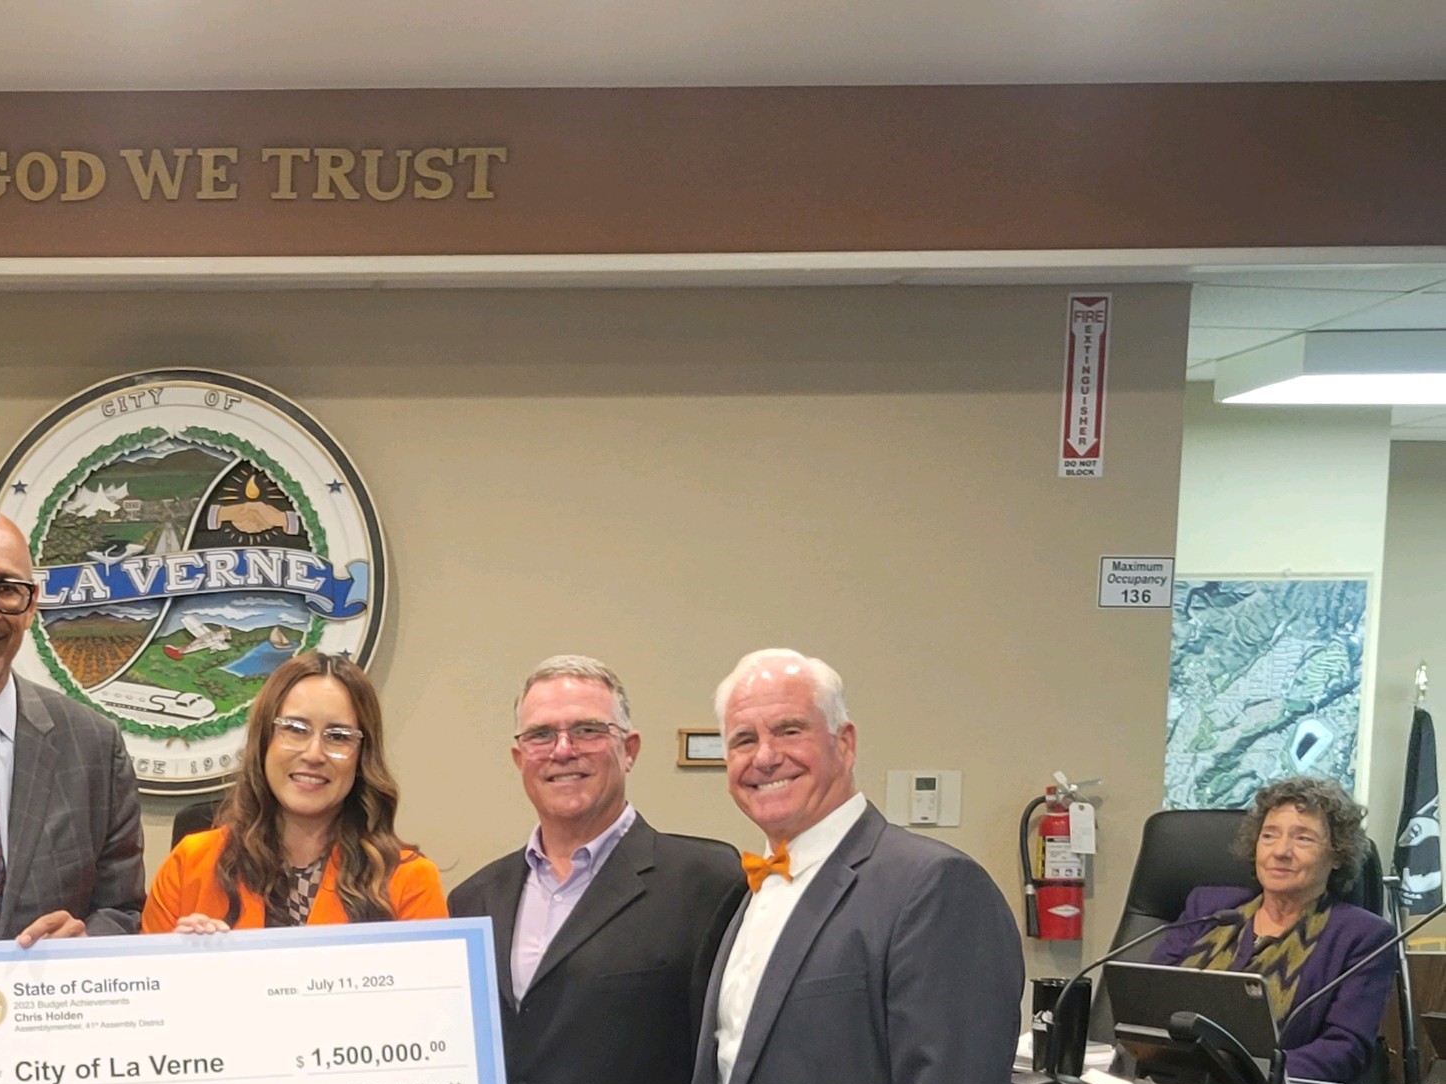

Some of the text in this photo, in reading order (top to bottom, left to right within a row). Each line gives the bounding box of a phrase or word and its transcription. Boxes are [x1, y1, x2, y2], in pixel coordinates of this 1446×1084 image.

[120, 147, 238, 200] WE
[262, 146, 507, 201] TRUST
[1073, 310, 1104, 324] FIRE
[1078, 325, 1093, 446] EXTINGUISHER
[101, 387, 241, 417] CITY OF
[1112, 561, 1163, 571] Maximum
[34, 549, 327, 606] LA VERNE
[1107, 573, 1167, 587] Occupancy
[1121, 589, 1151, 603] 136
[13, 977, 161, 997] State of California
[306, 975, 394, 992] July 11, 2023
[267, 987, 299, 996] DATED:
[13, 997, 130, 1010] 2023 Budget Achievements
[14, 1011, 83, 1022] Chris Holden
[100, 1020, 137, 1030] Assembly
[138, 1019, 164, 1028] District
[75, 1057, 101, 1079] of
[110, 1057, 140, 1078] La
[148, 1054, 225, 1075] Verne
[295, 1056, 305, 1069] $
